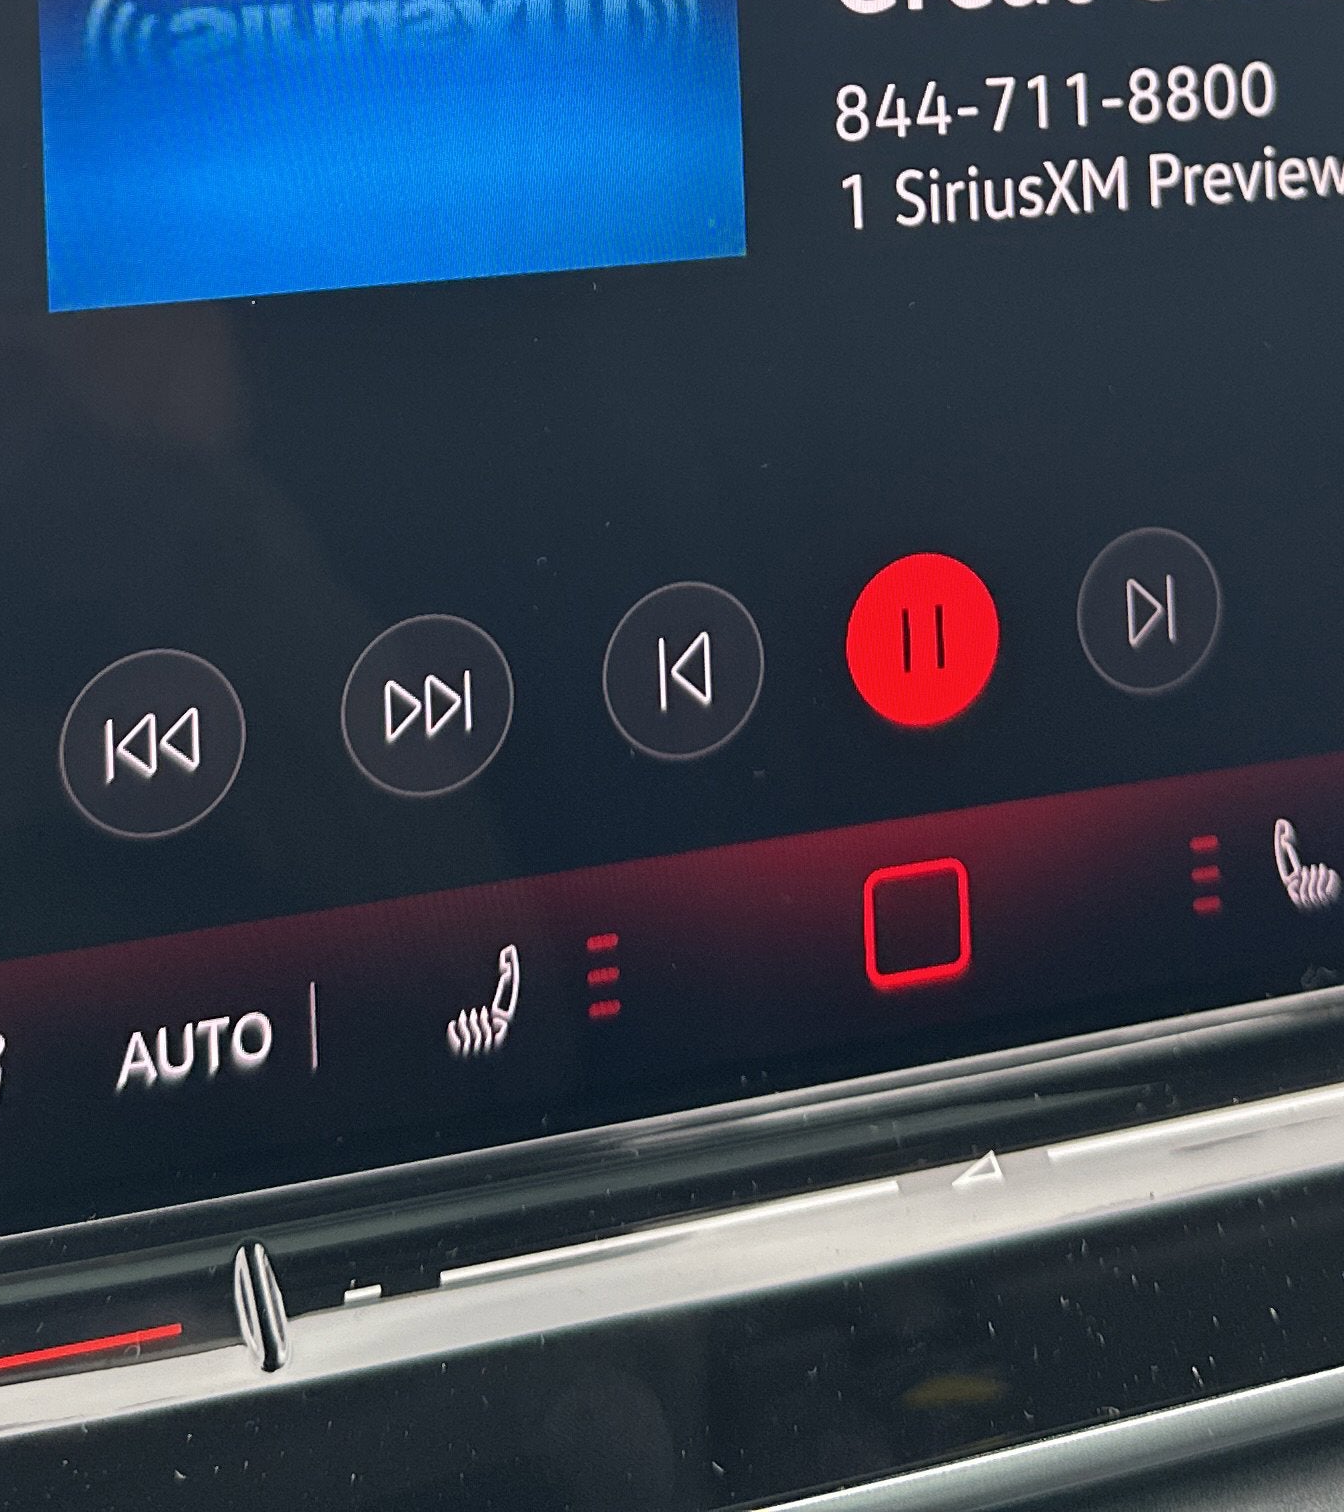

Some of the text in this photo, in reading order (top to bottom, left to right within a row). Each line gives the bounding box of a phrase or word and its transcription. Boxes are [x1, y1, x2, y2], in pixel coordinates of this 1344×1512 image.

[834, 59, 1277, 143] 844-711-8800
[841, 173, 866, 229] 1
[895, 155, 1129, 227] SiriusXM
[115, 1011, 273, 1092] AUTO
